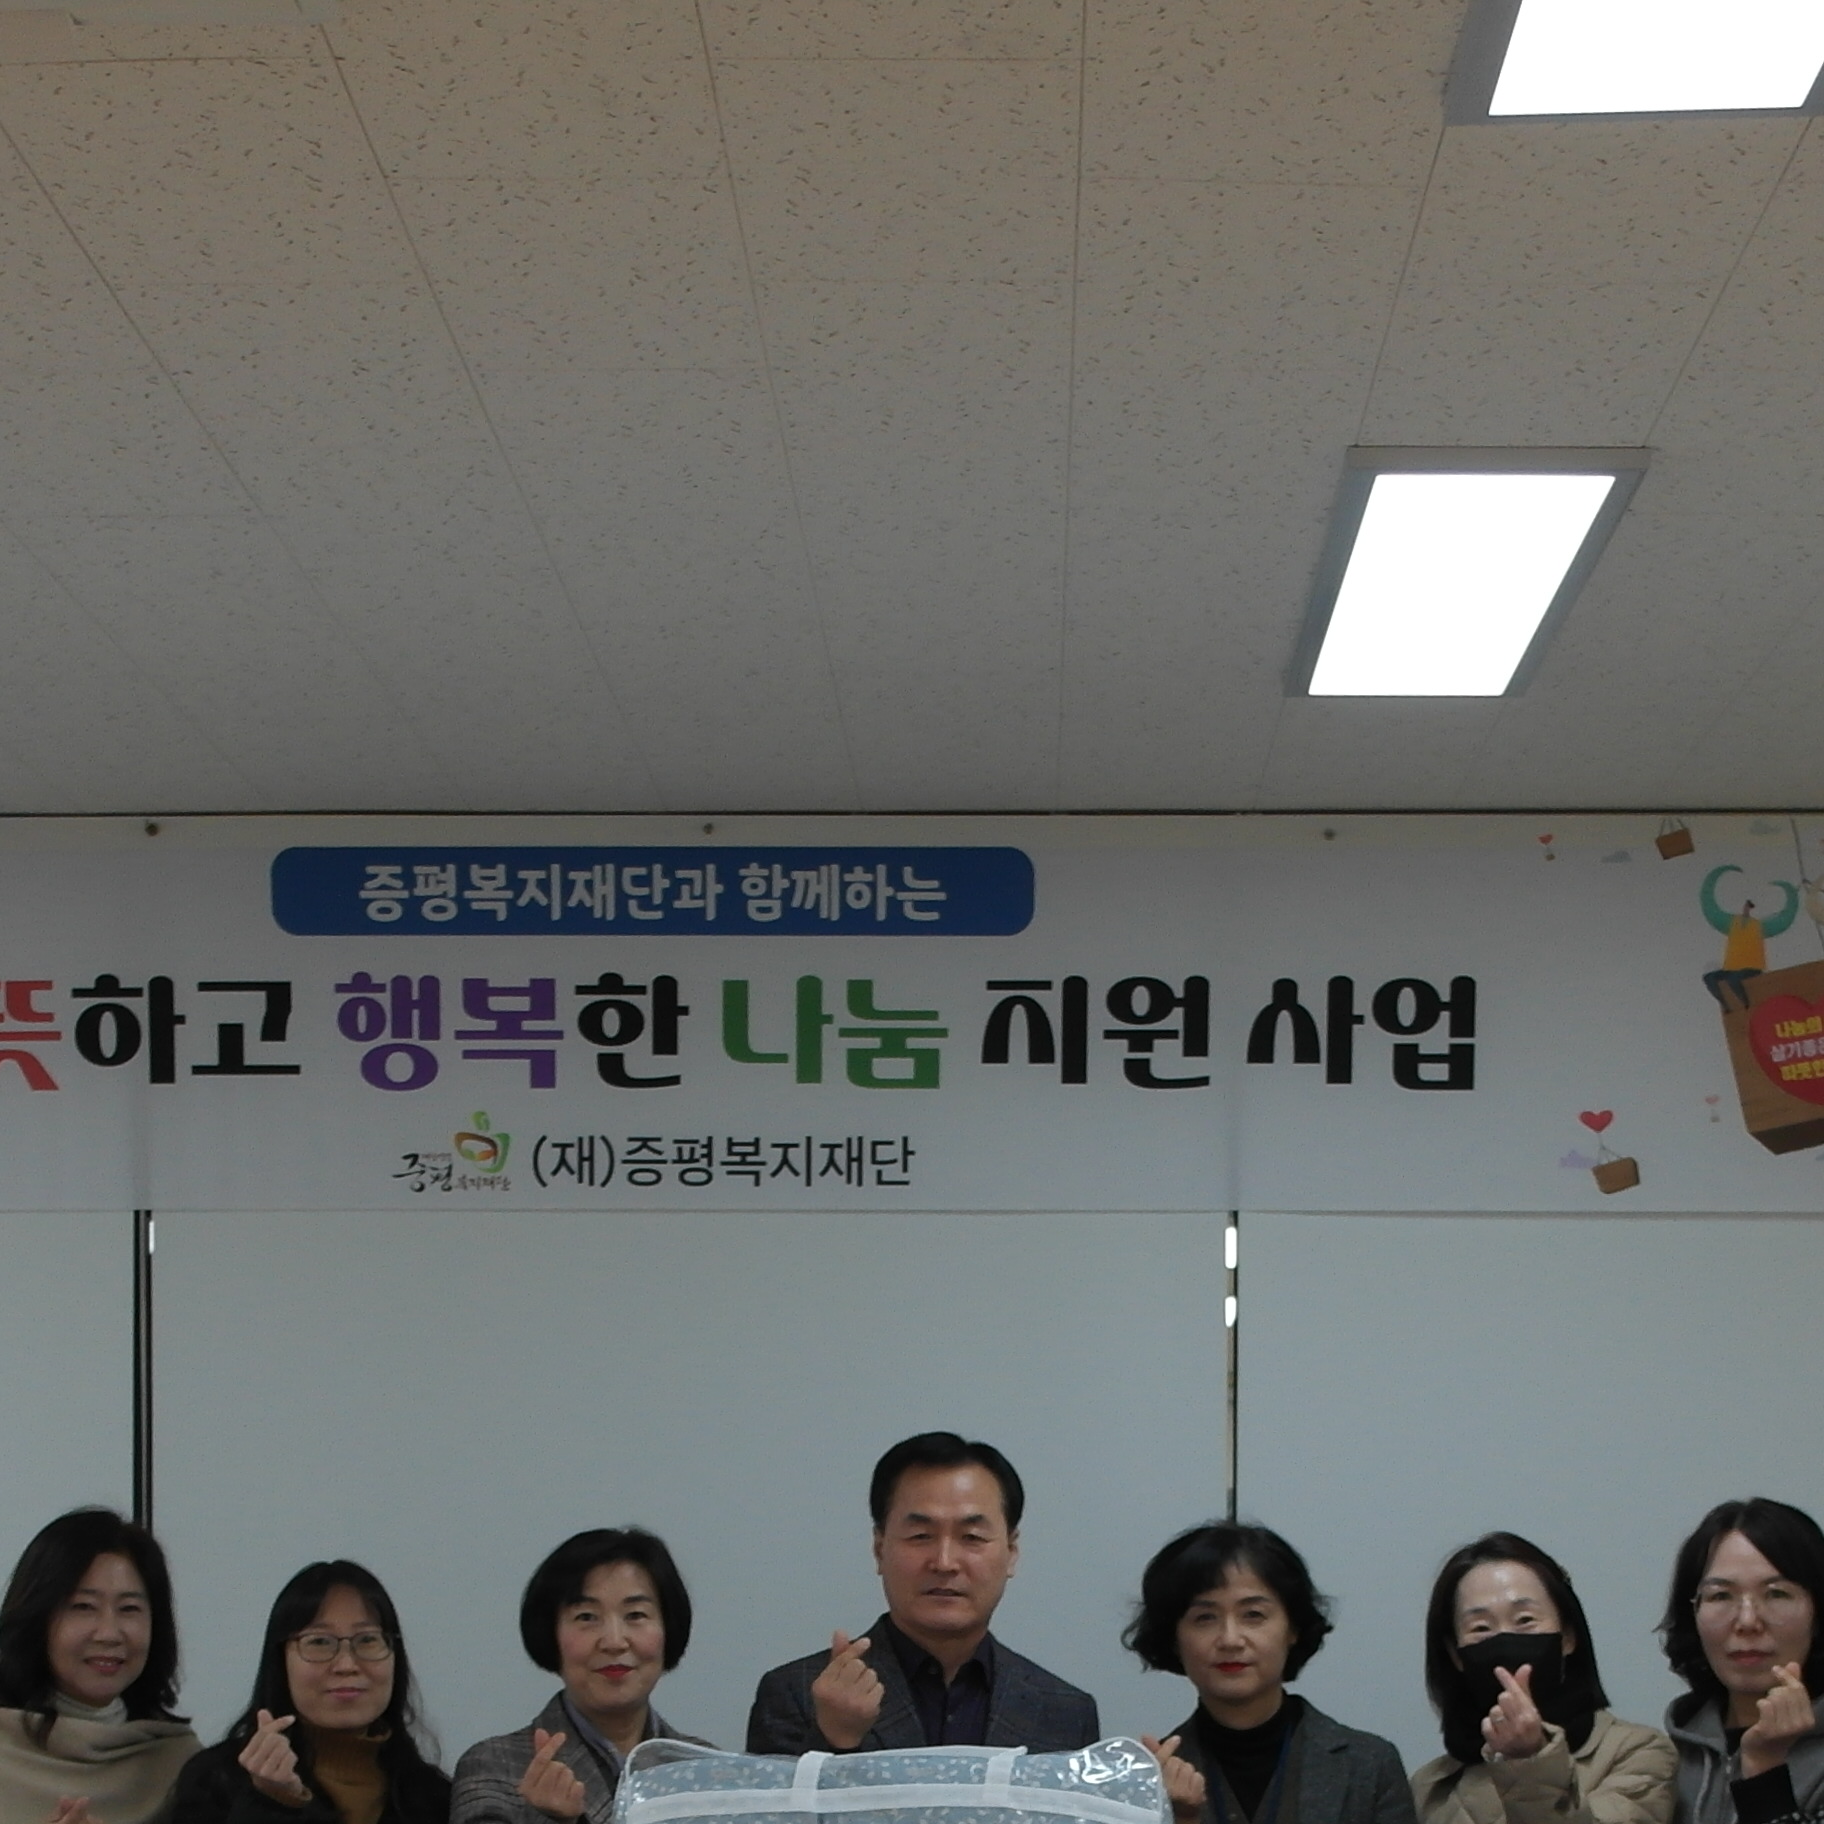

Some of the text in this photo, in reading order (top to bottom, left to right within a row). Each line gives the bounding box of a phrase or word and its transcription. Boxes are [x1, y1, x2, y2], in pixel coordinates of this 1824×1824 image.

[358, 863, 948, 922] 증평복지재단과 함께하는
[334, 971, 690, 1092] 행복한
[721, 974, 949, 1090] 나눔
[980, 974, 1211, 1090] 지원
[1246, 974, 1477, 1091] 사업
[1774, 1016, 1822, 1038] 나눔의
[532, 1134, 917, 1188] (재)증평복지재단
